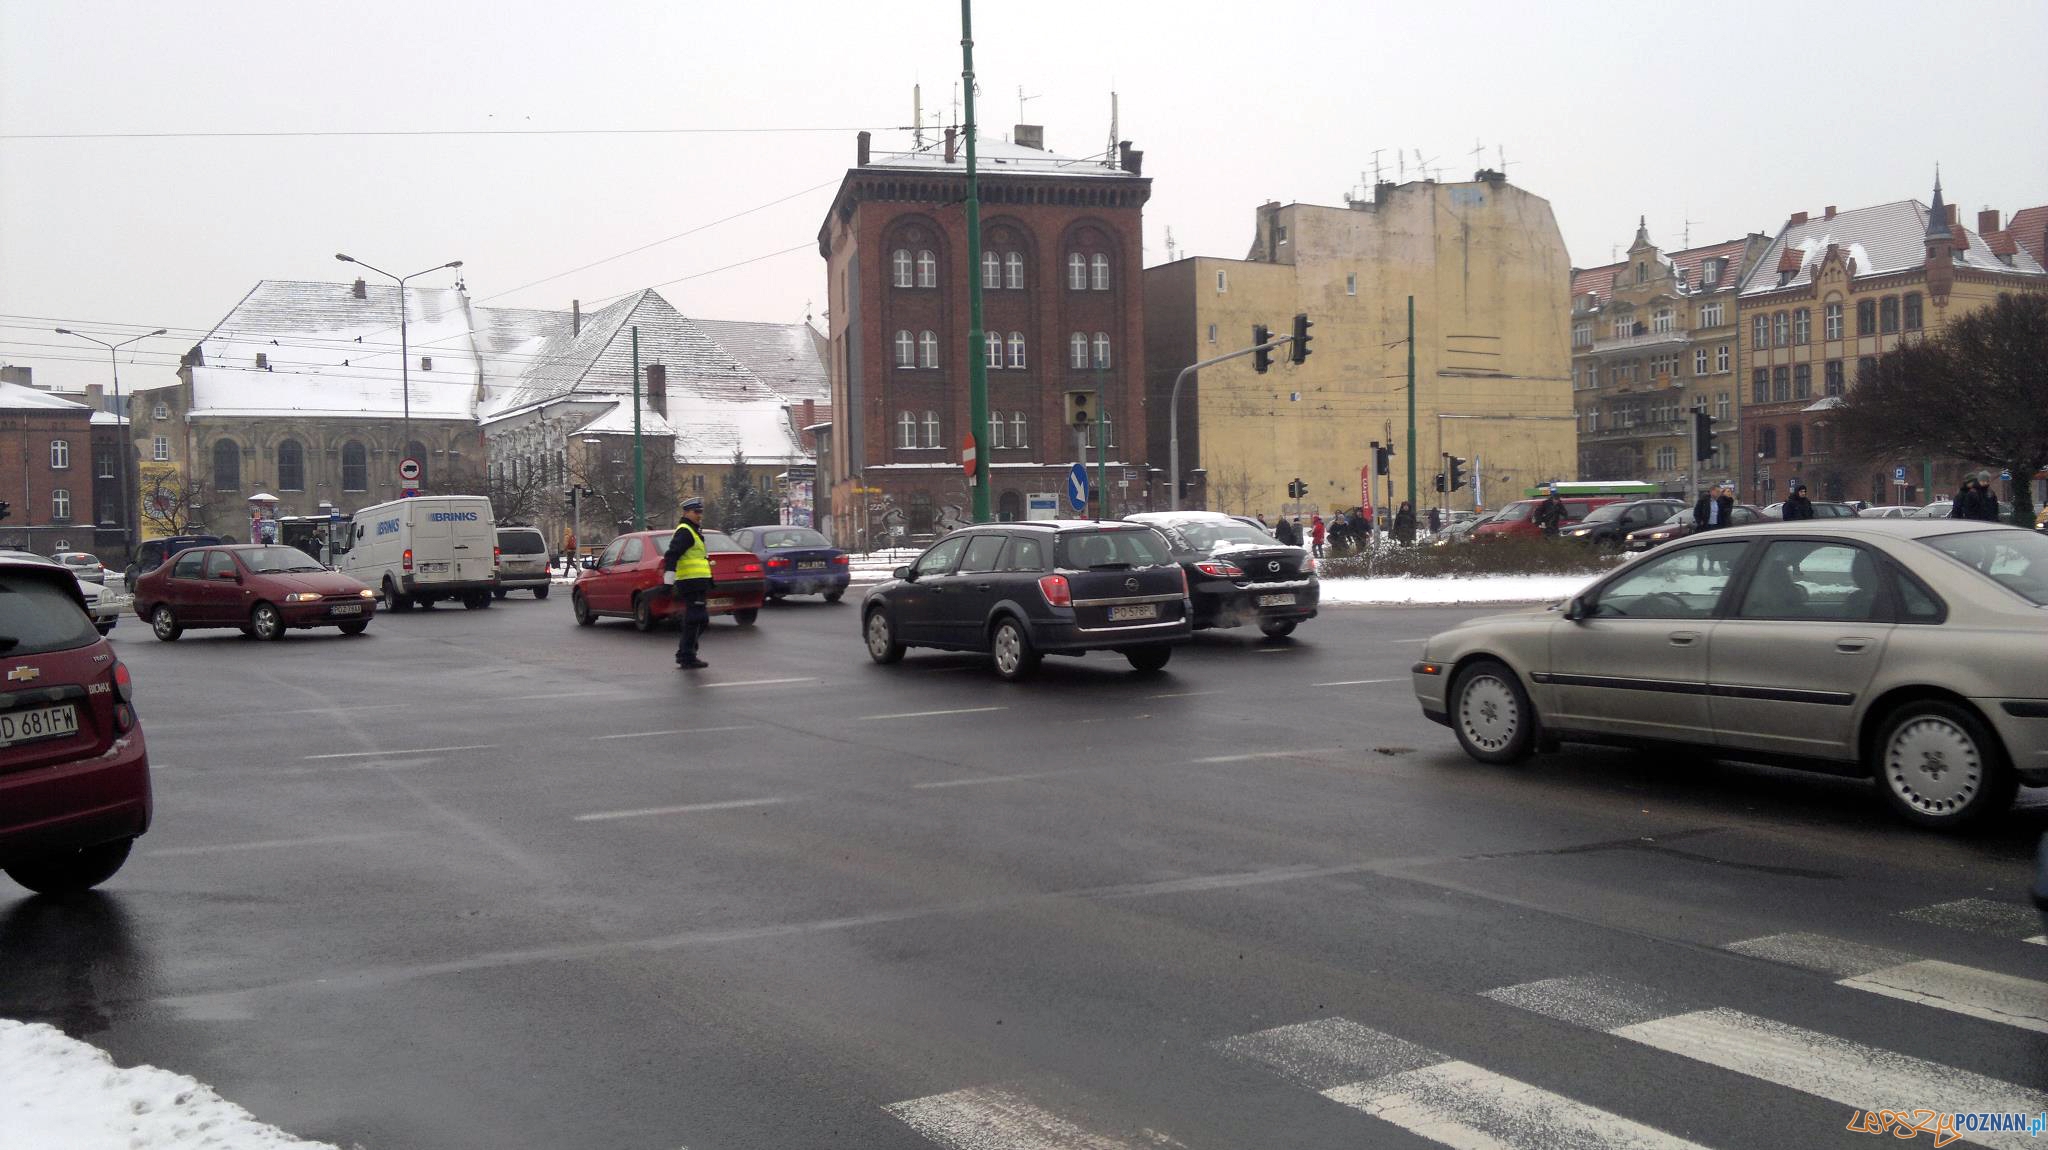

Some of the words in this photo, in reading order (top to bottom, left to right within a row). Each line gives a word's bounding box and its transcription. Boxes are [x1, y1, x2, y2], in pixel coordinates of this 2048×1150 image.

[435, 512, 478, 522] BRINKS
[378, 518, 400, 535] BRINKS
[1114, 607, 1126, 618] PO
[0, 716, 14, 739] D
[22, 707, 74, 735] 681FW
